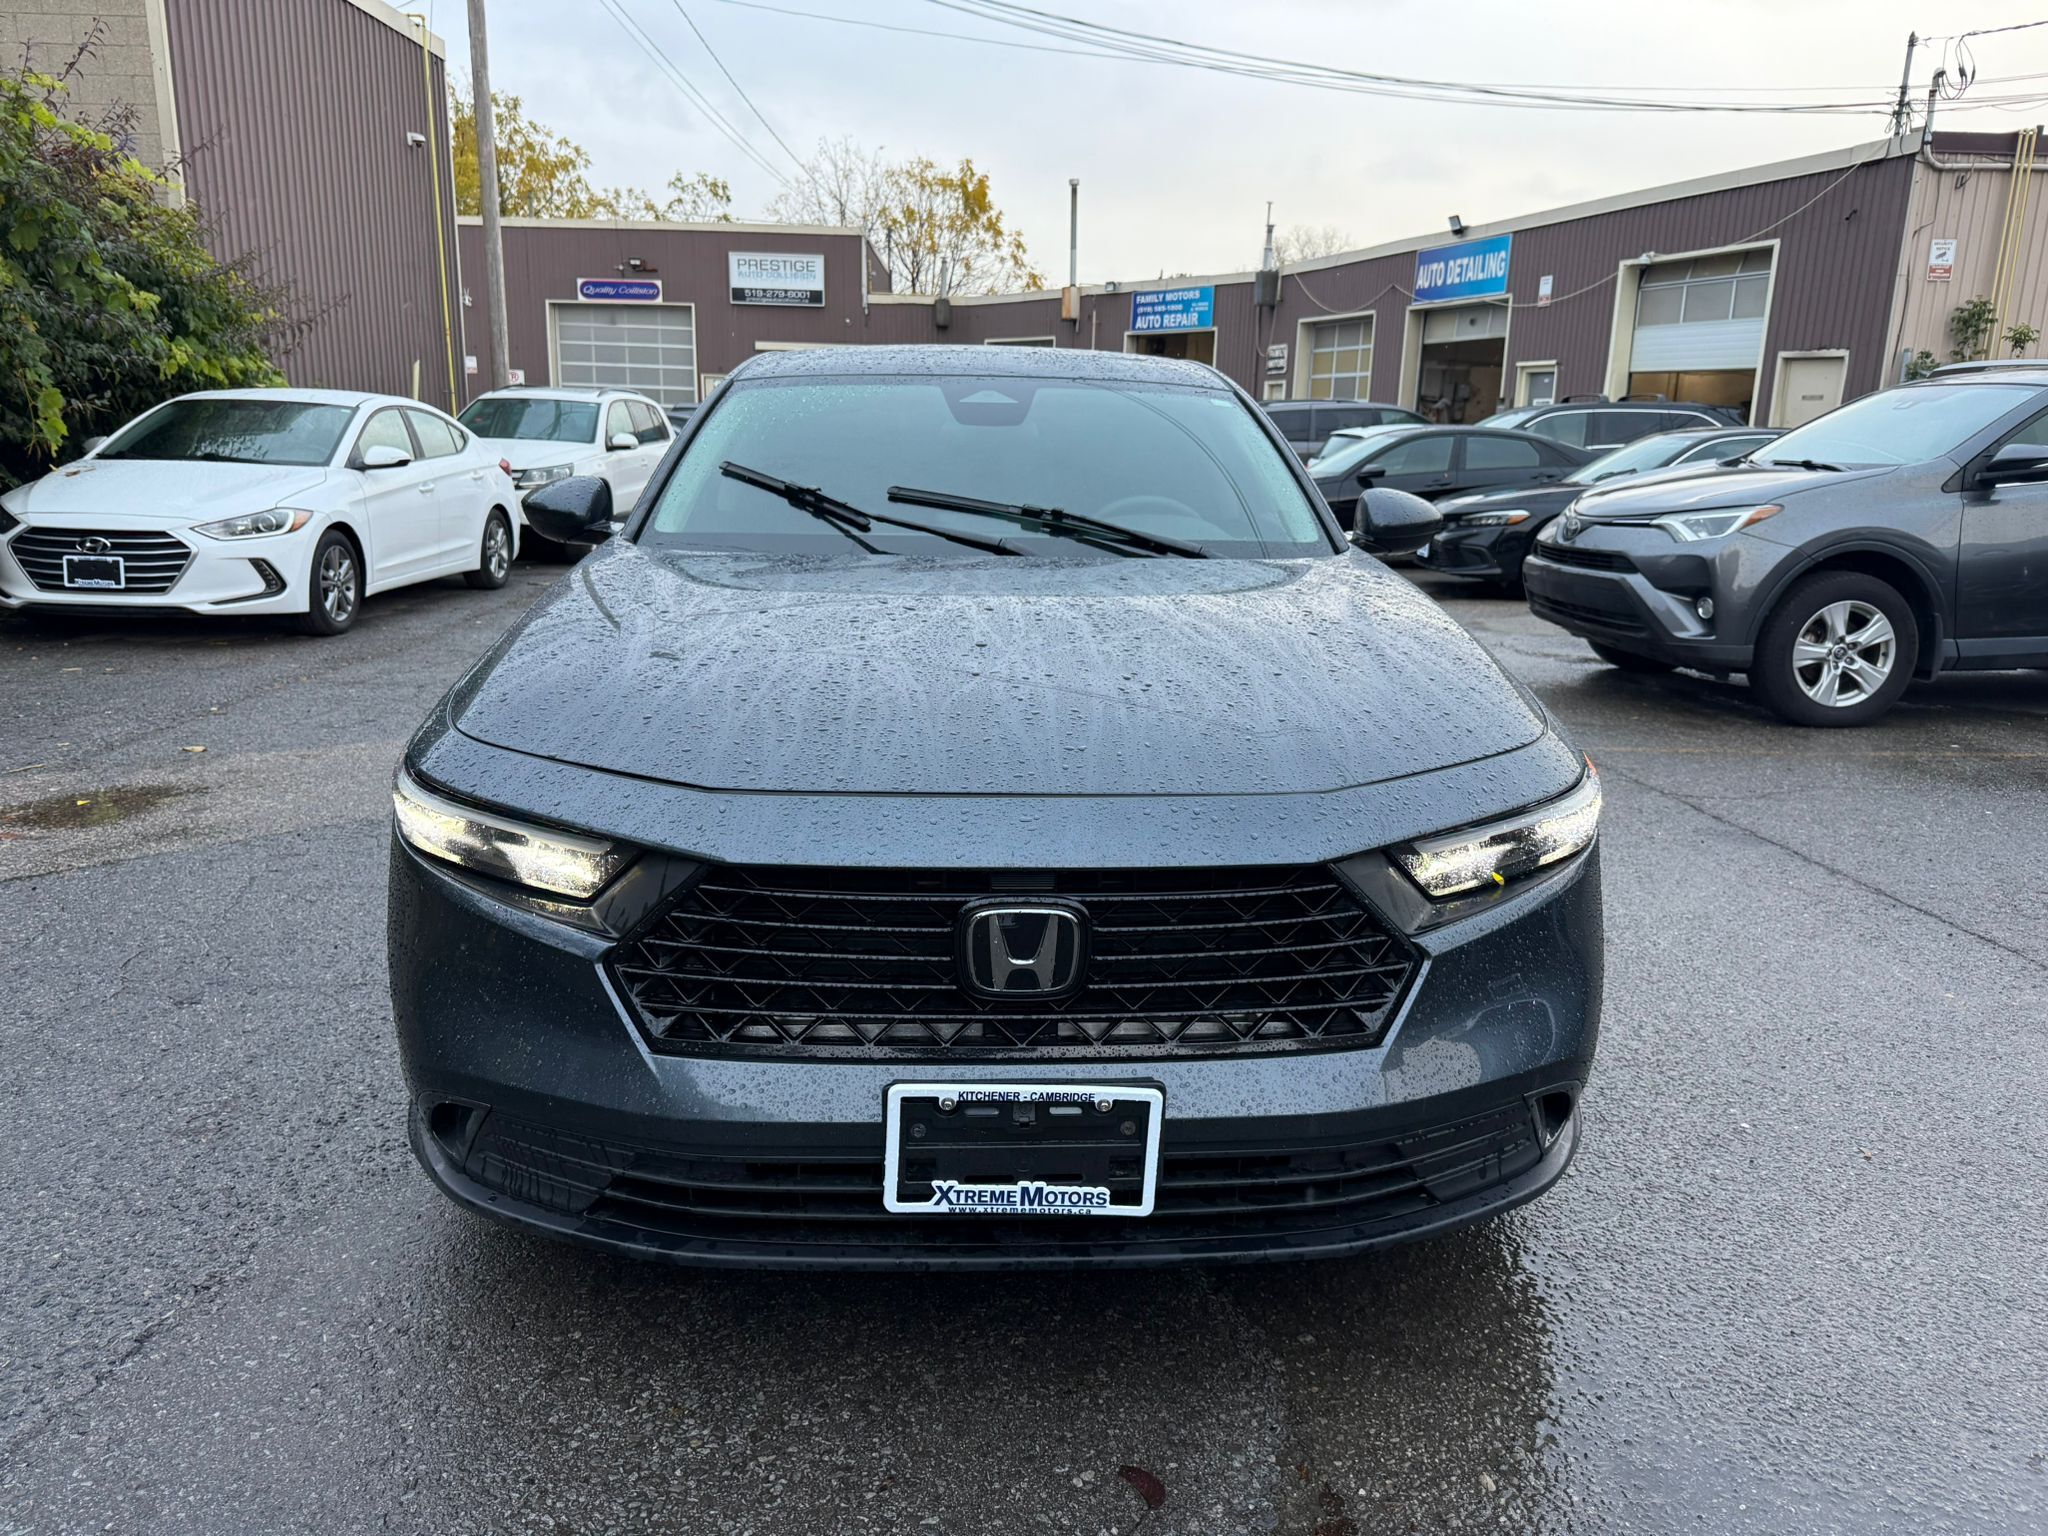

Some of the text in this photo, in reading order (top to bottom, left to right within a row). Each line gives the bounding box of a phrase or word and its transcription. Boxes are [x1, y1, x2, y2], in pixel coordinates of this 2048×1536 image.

[737, 258, 816, 272] PRESTIGE
[1416, 250, 1506, 290] AUTO DETAILING
[583, 285, 657, 295] Quality Collision
[744, 289, 810, 299] 519-279-6001
[1136, 290, 1200, 304] FAMILY MOTORS
[1135, 312, 1199, 329] AUTO REPAIR
[958, 1091, 1020, 1101] KITCHENER
[1030, 1092, 1095, 1102] CAMBRIDGE
[933, 1186, 1107, 1207] XTREME MOTORS
[948, 1206, 1092, 1215] www.xtrememotors.ca
